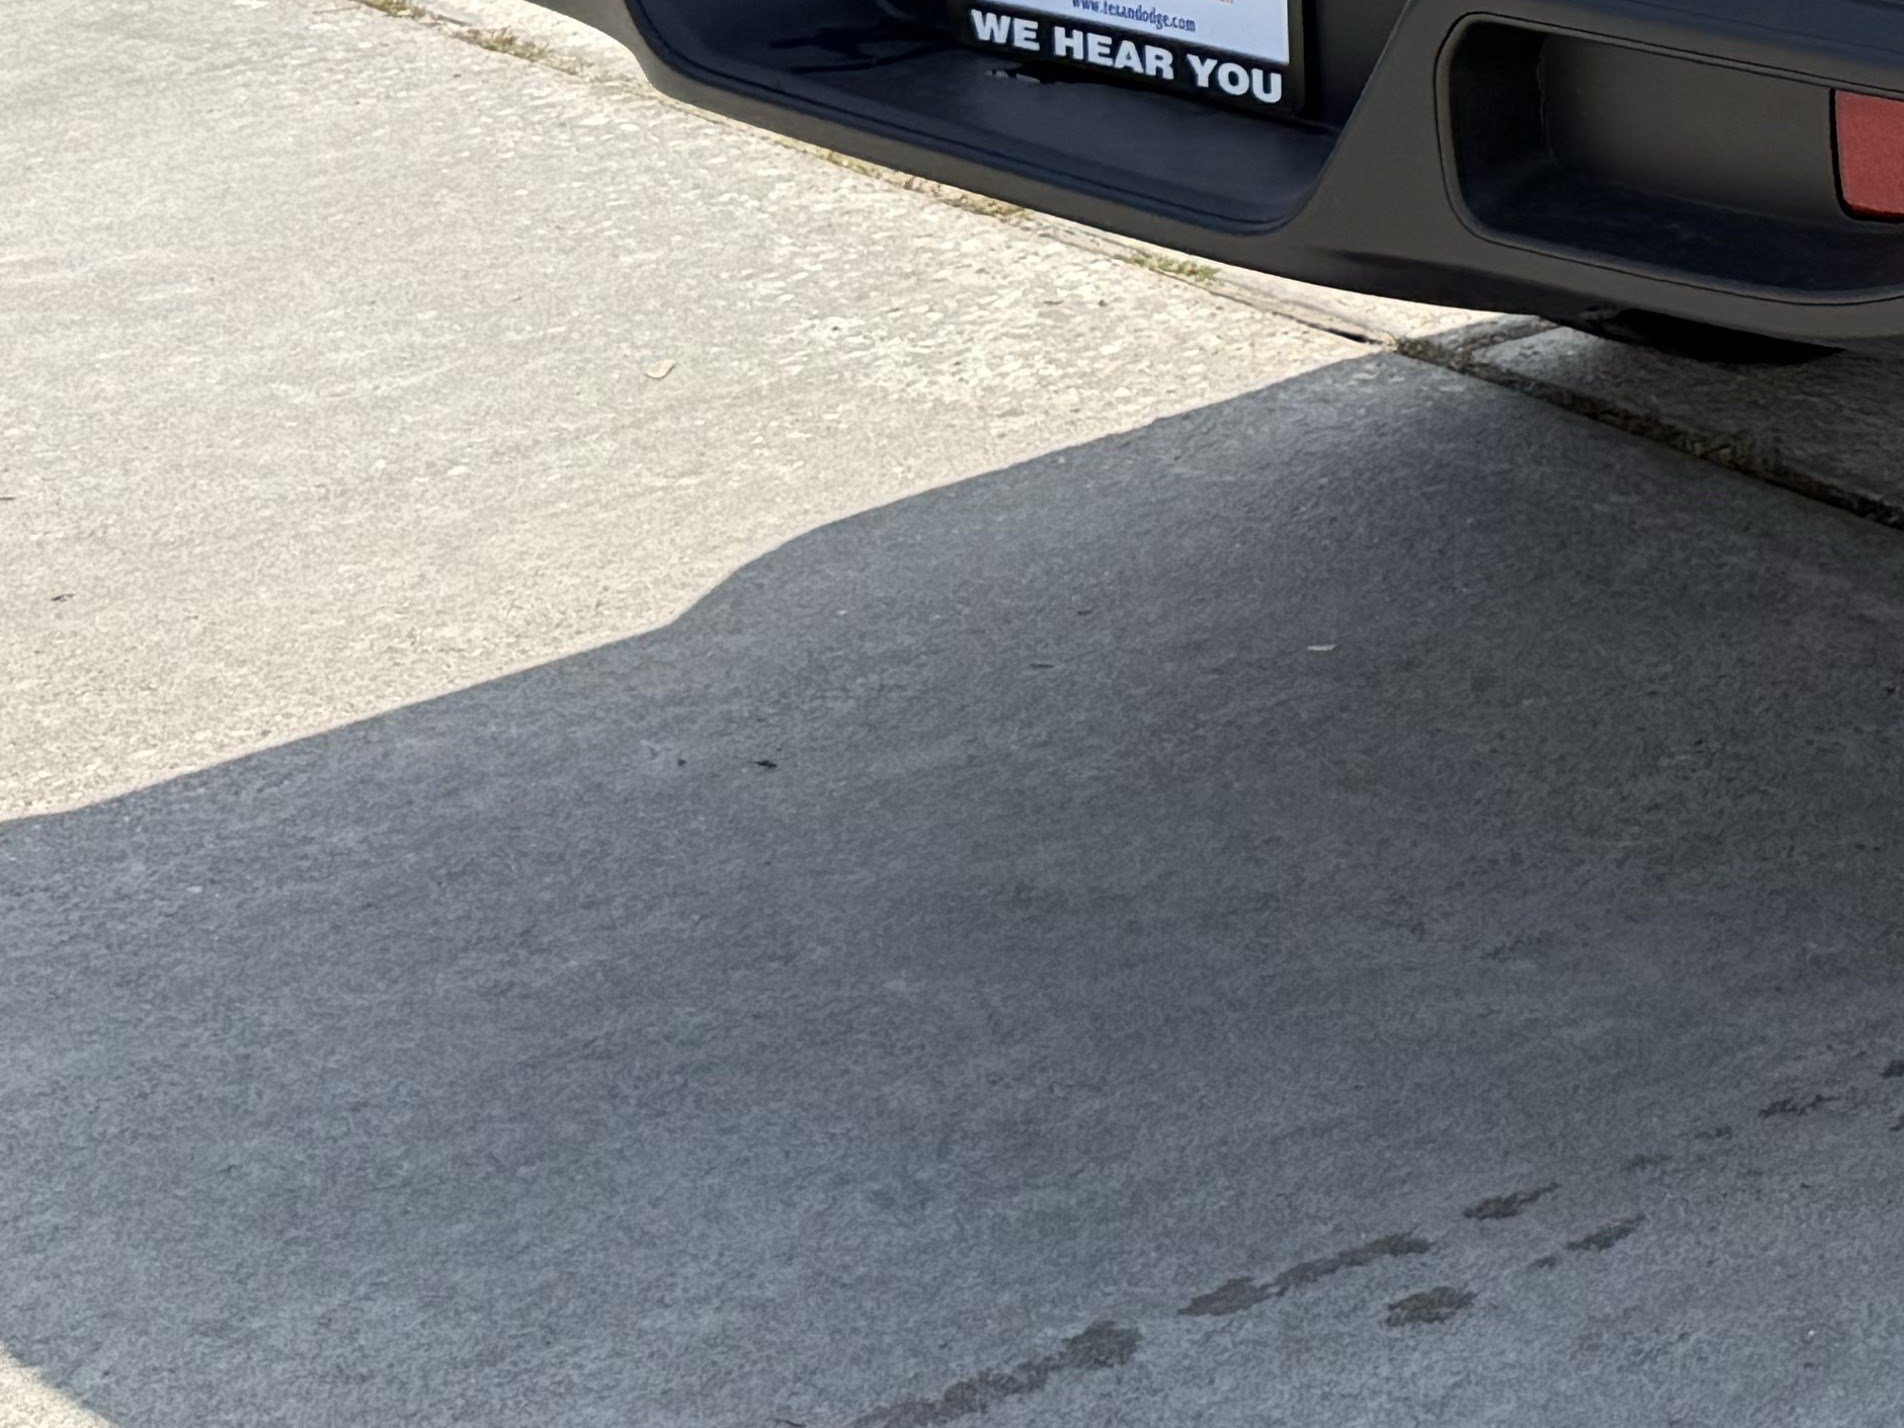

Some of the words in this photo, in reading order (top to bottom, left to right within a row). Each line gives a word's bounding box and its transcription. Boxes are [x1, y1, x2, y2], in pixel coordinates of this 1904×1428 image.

[970, 8, 1041, 53] WE
[1053, 25, 1175, 81] HEAR
[1186, 52, 1283, 105] YOU
